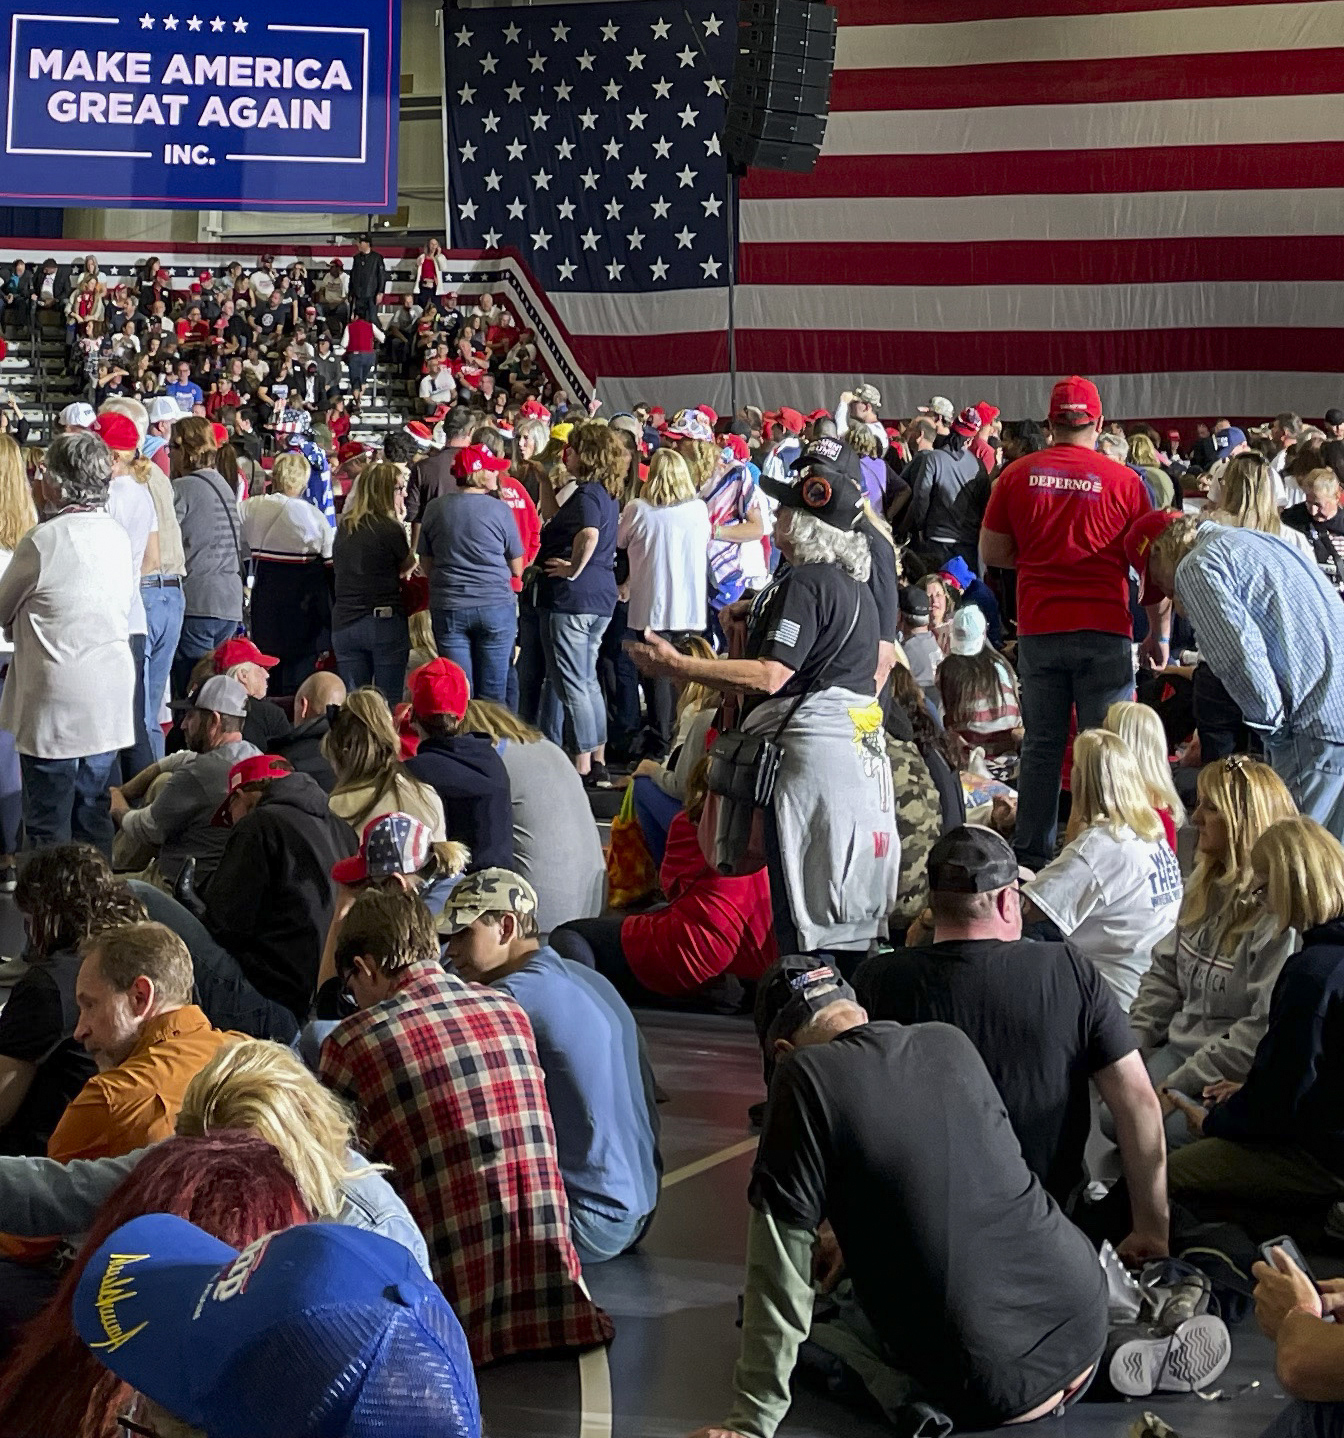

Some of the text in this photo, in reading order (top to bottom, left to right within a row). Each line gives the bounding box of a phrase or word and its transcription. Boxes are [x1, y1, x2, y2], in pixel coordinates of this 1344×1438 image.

[29, 48, 353, 91] MAKE AMERICA
[47, 90, 332, 130] GREAT AGAIN
[164, 143, 216, 166] INC.
[1028, 474, 1092, 492] DEPERNO
